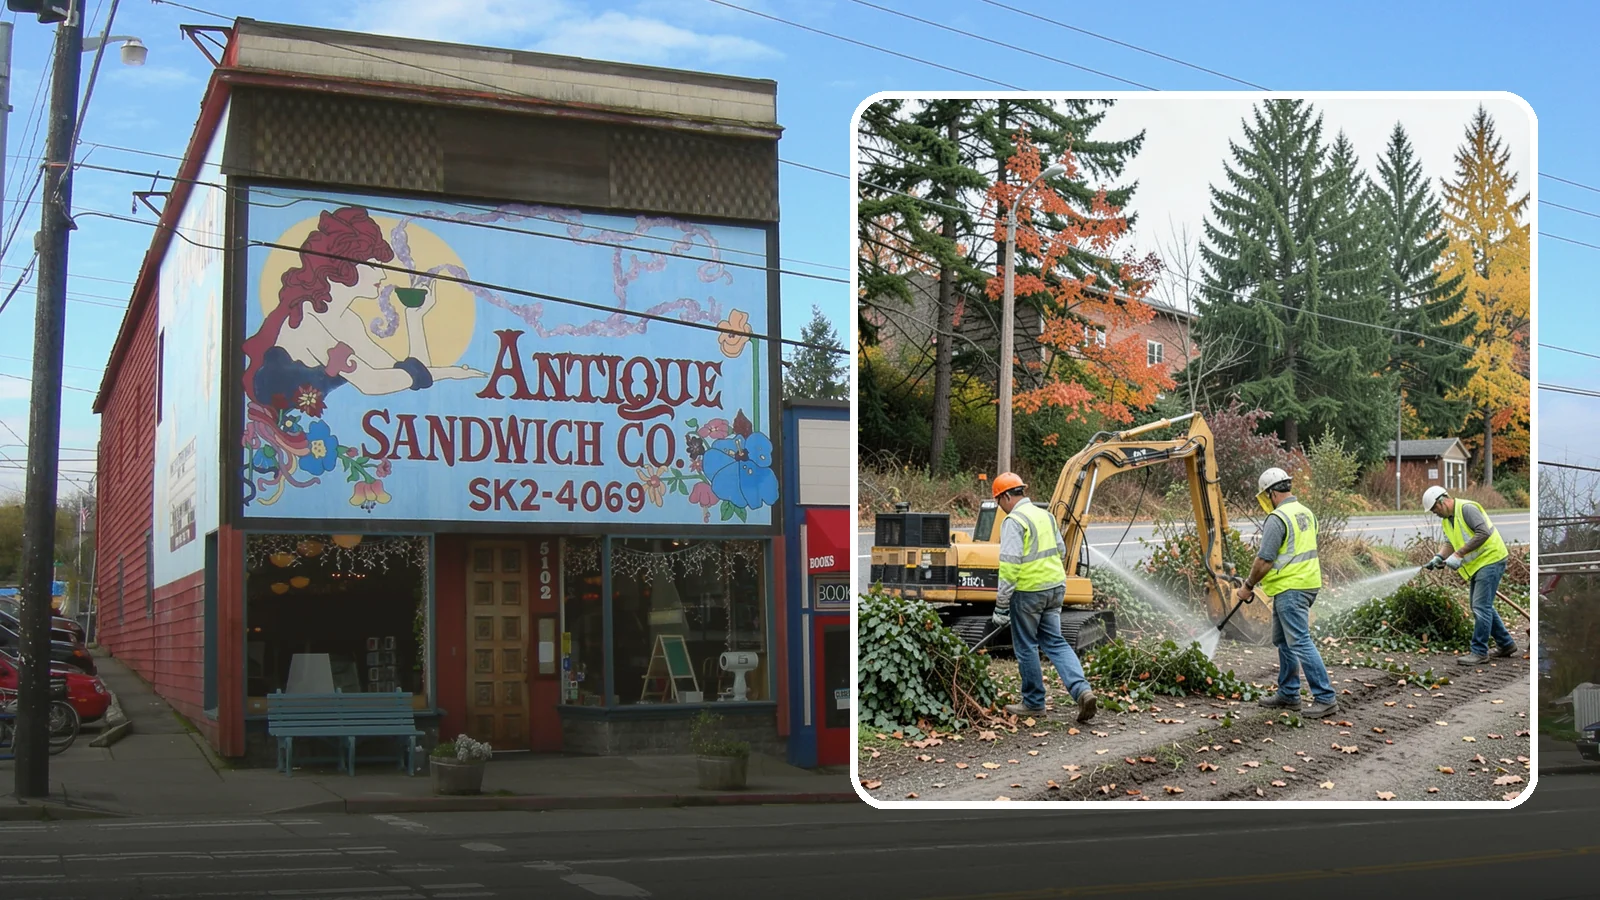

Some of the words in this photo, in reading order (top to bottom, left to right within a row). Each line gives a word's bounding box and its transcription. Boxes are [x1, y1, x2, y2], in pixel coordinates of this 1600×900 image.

[475, 328, 724, 421] ANTIQUE
[361, 408, 604, 467] SANDWICH
[617, 421, 685, 468] CO.
[468, 477, 646, 513] SK2-4069
[539, 541, 552, 600] 5102
[809, 555, 835, 569] BOOKS
